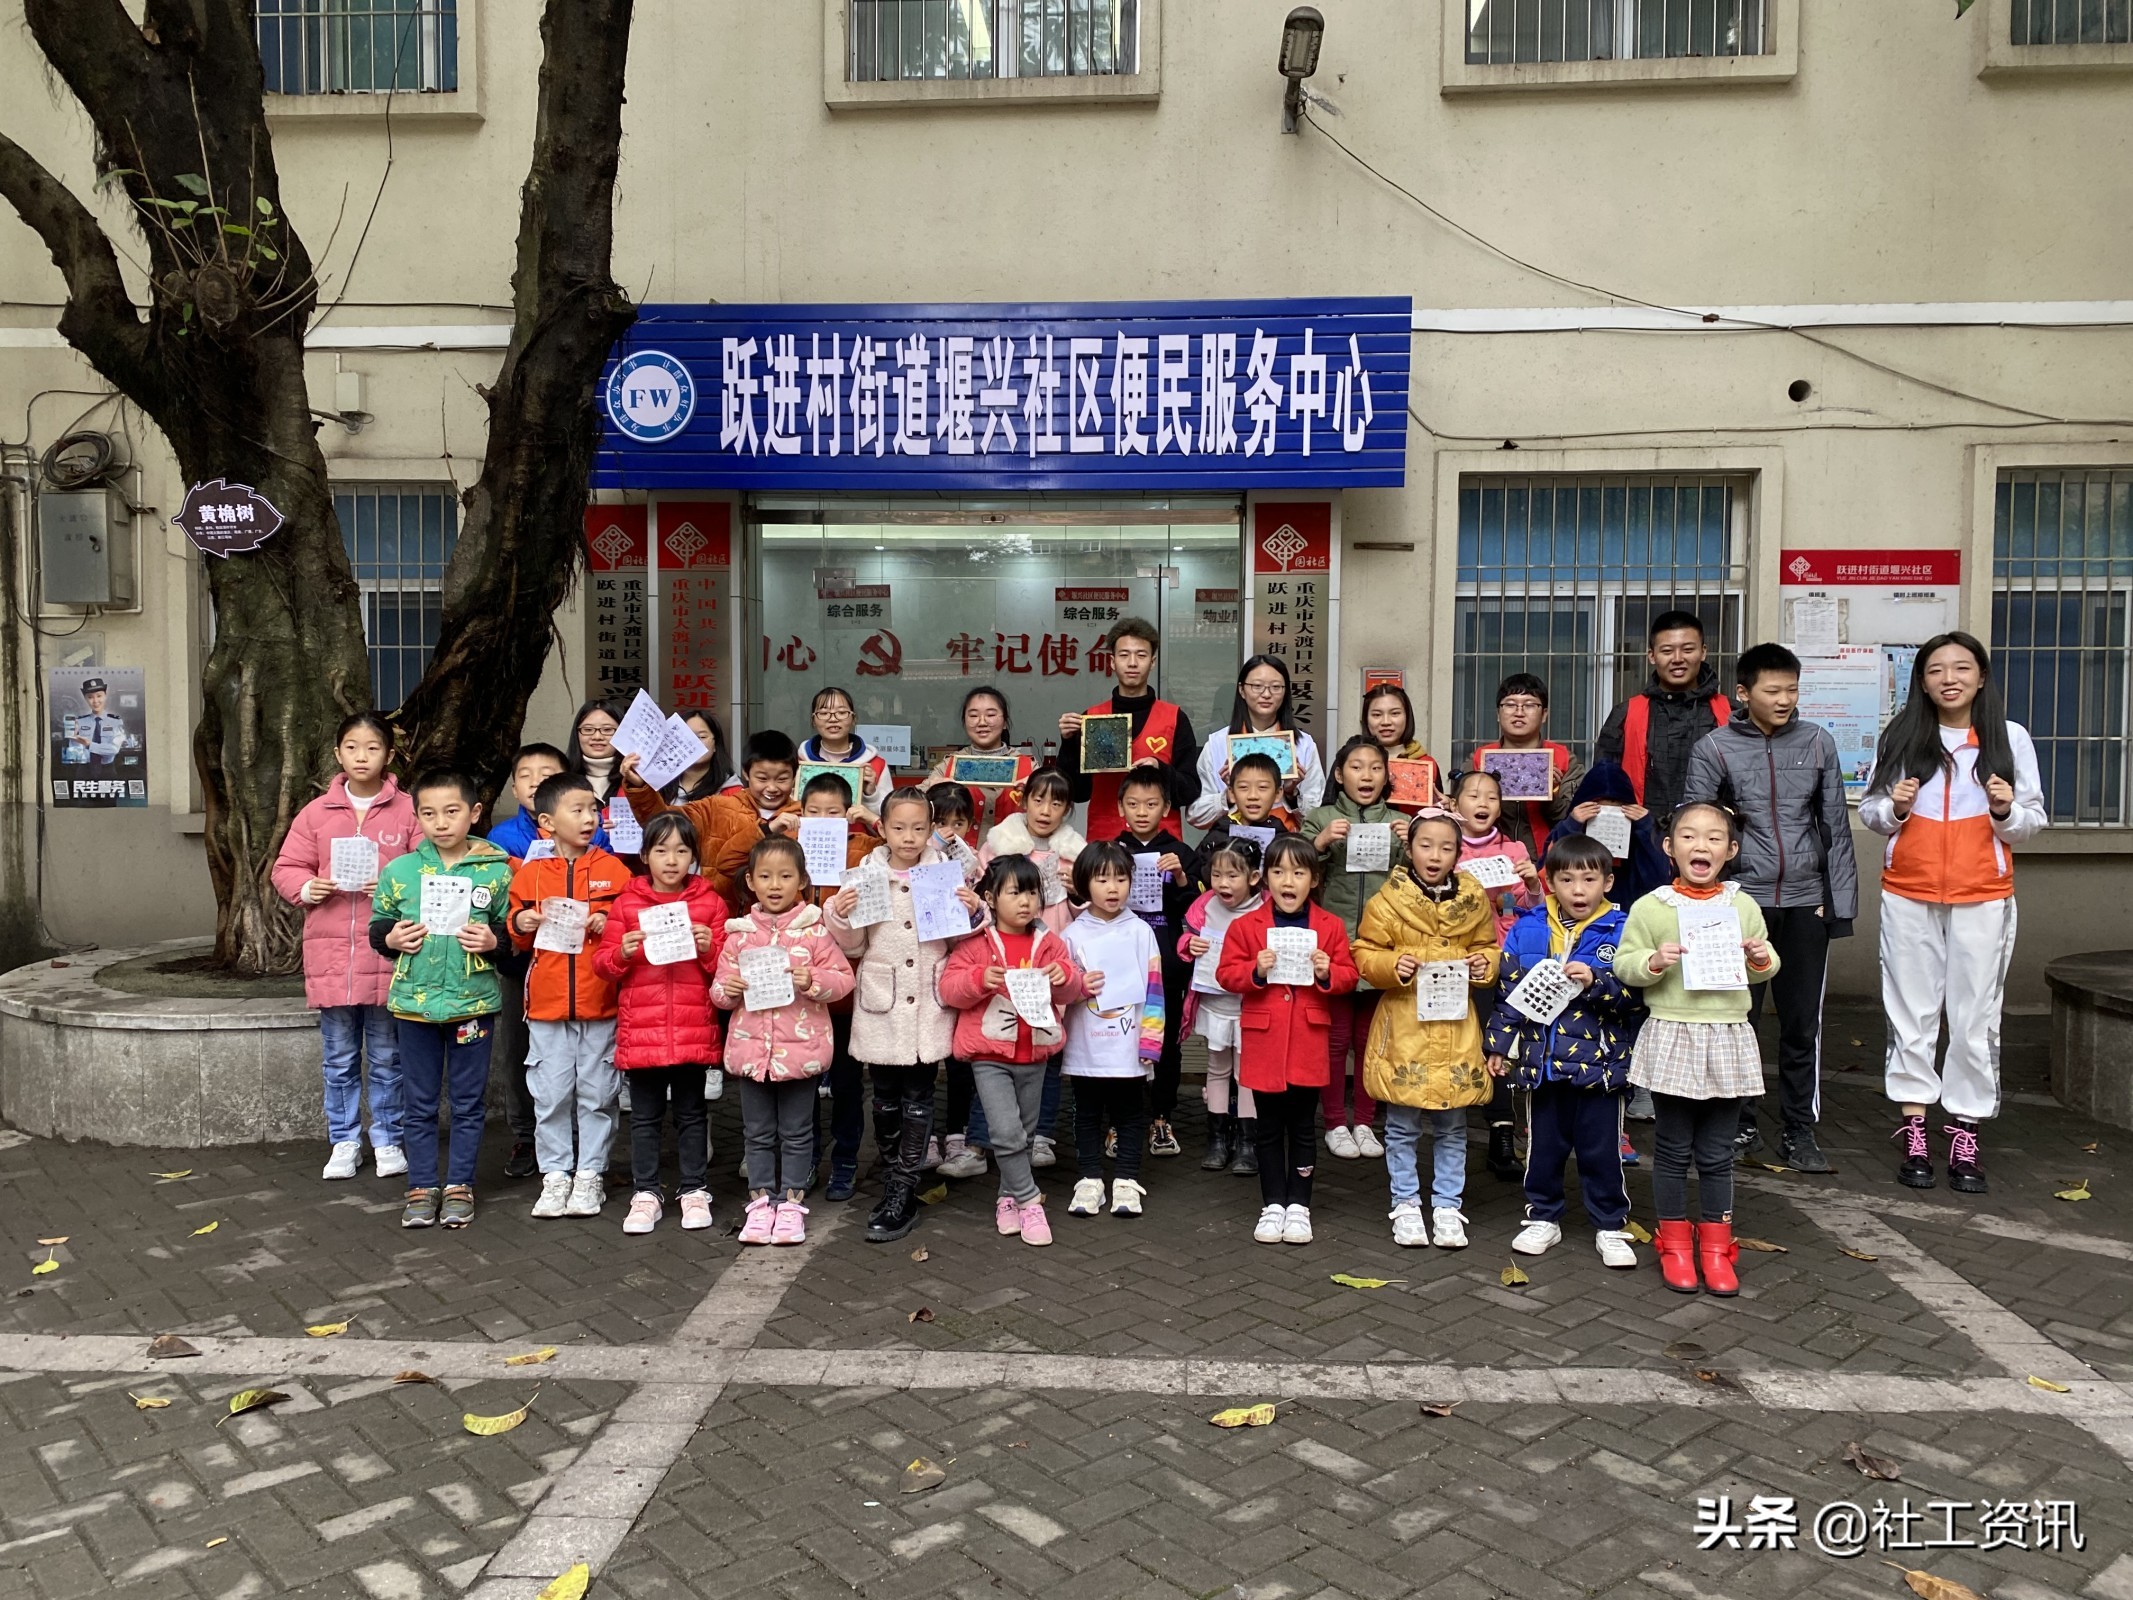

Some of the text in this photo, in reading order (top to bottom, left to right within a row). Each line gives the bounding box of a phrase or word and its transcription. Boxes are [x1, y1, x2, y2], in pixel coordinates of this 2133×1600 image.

[628, 388, 673, 409] FW
[720, 327, 1374, 459] 跃进村街道堰兴社区便民服务中心
[198, 503, 255, 524] 黄桷树
[1836, 564, 1933, 575] 跃进村街道堰兴社区
[597, 579, 617, 660] 跃进村街道
[622, 579, 642, 660] 重庆市大渡口区
[672, 578, 691, 669] 重庆市大渡口区
[697, 578, 718, 670] 中国共产党
[826, 603, 884, 618] 综合服务
[1063, 606, 1120, 621] 综合服务
[1293, 581, 1315, 675] 重庆市大渡口区
[671, 674, 718, 719] 跃进
[476, 891, 488, 901] 78
[589, 880, 612, 888] SPORT
